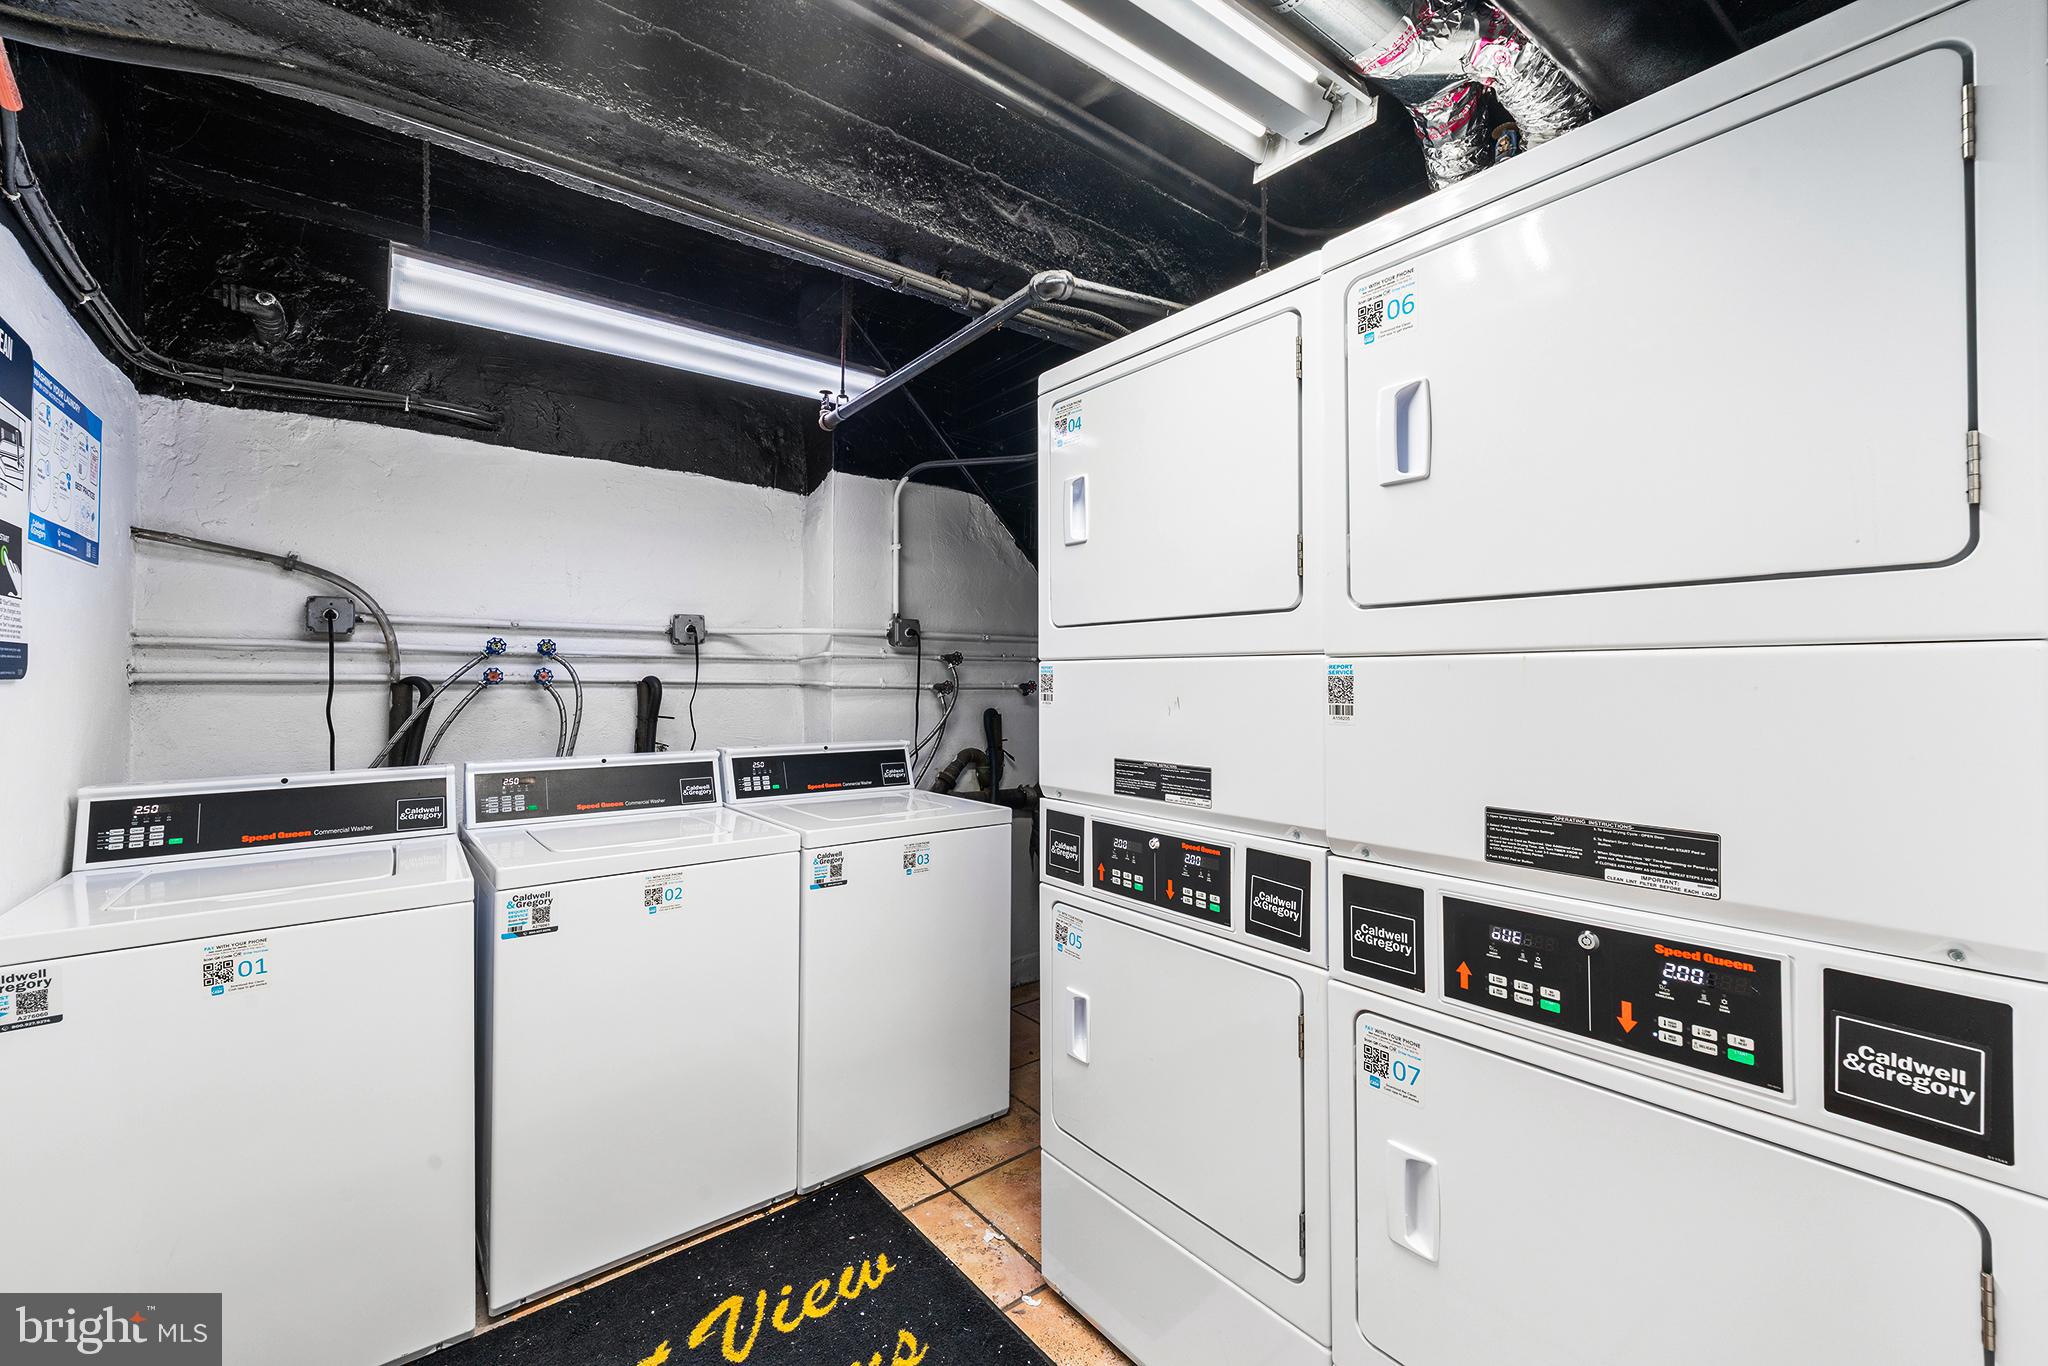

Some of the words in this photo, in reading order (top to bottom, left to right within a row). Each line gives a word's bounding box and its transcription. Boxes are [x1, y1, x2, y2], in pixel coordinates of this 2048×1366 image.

[1387, 293, 1415, 319] 06
[1068, 416, 1082, 432] 04
[807, 782, 825, 790] Speed
[825, 781, 842, 789] Queen
[134, 804, 159, 814] 2.50
[405, 806, 440, 814] Caldwell
[576, 803, 600, 811] Speed
[399, 811, 442, 820] &Gregory
[1554, 815, 1586, 824] OPERATING
[1588, 820, 1632, 830] INSTRUCTIONS
[241, 832, 277, 843] Speed
[277, 829, 312, 839] Queen
[313, 826, 350, 836] Commercial
[350, 824, 374, 832] Washer
[1051, 845, 1078, 861] &Gregory
[1054, 841, 1077, 852] Caldwell
[1182, 842, 1201, 852] Speed
[1201, 846, 1221, 856] Queen
[917, 854, 929, 865] 03
[1641, 876, 1679, 886] IMPORTANT:
[1660, 884, 1681, 892] BEFORE
[513, 891, 550, 902] Caldwell
[665, 887, 682, 901] 02
[1258, 891, 1297, 910] Caldwell
[507, 898, 553, 909] &Gregory
[1253, 897, 1299, 921] &Gregory
[1069, 932, 1082, 949] 05
[1361, 924, 1407, 943] Caldwell
[1354, 930, 1412, 956] &Gregory
[1654, 943, 1701, 961] Speed
[1703, 953, 1754, 972] Queen
[238, 958, 268, 977] 01
[1663, 962, 1704, 984] 2.00
[1375, 1028, 1386, 1036] WITH
[1387, 1032, 1402, 1041] YOUR
[1402, 1038, 1421, 1048] PHONE
[1392, 1060, 1421, 1086] 07
[1858, 1045, 1966, 1085] Caldwell
[1842, 1052, 1976, 1106] &Gregory
[687, 1253, 896, 1363] View
